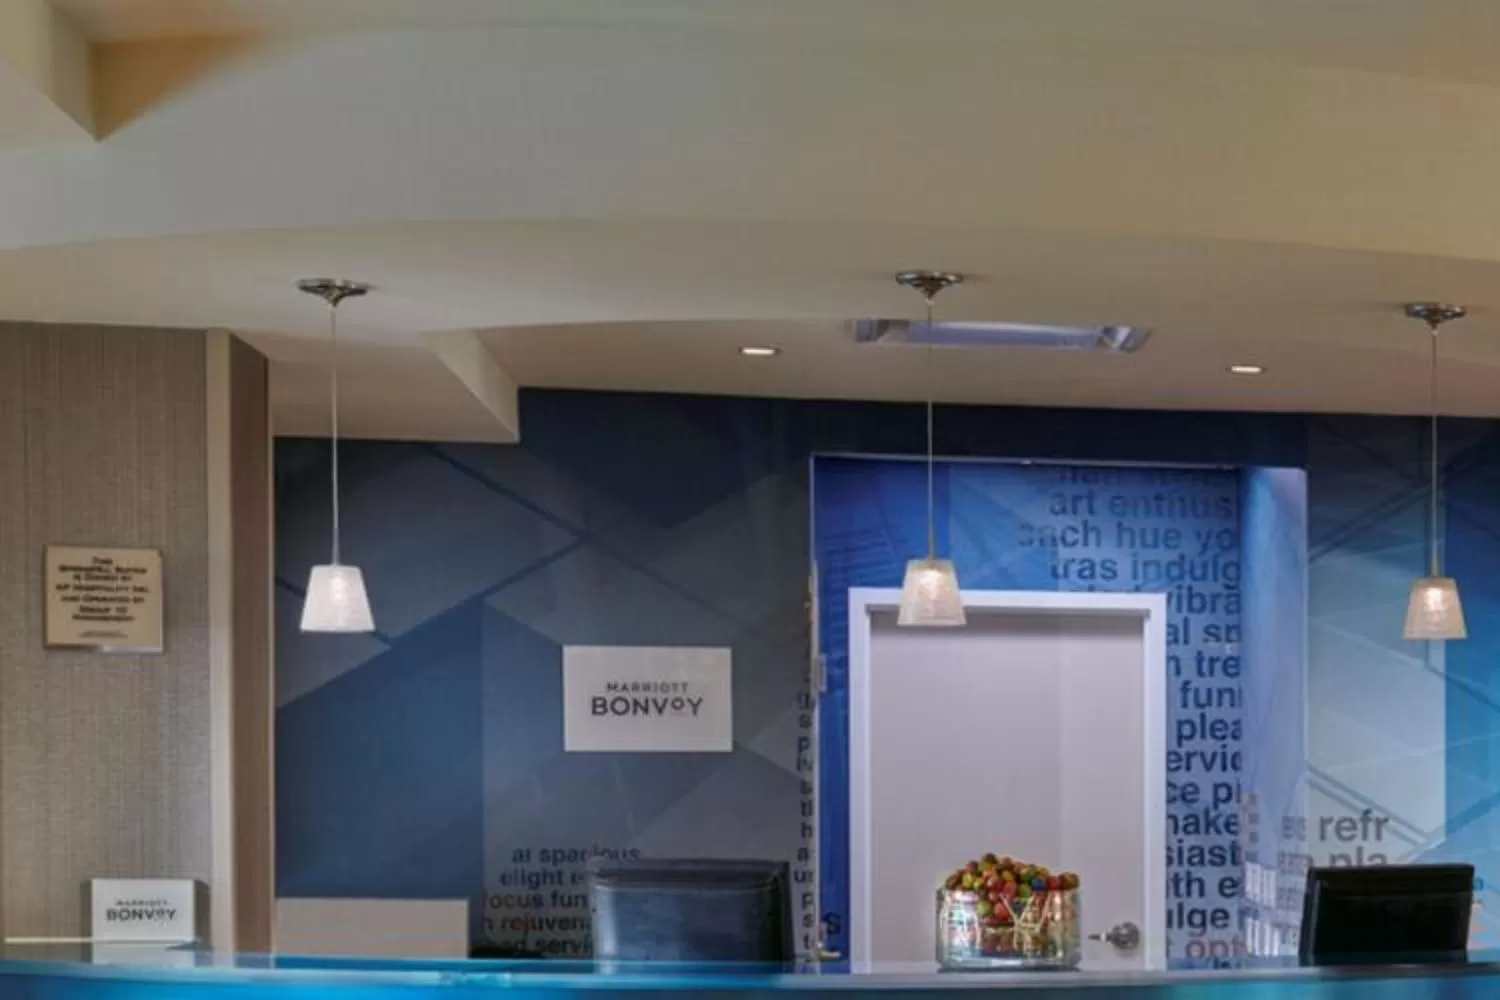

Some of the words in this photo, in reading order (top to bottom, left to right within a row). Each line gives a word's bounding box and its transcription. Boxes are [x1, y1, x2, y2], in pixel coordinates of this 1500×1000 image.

[1050, 488, 1098, 516] art
[1116, 520, 1183, 549] hue
[1195, 649, 1241, 679] tre
[606, 681, 689, 693] MARRIOTT
[1179, 679, 1243, 709] fun
[591, 695, 703, 716] BONVOY
[1319, 808, 1389, 842] refr
